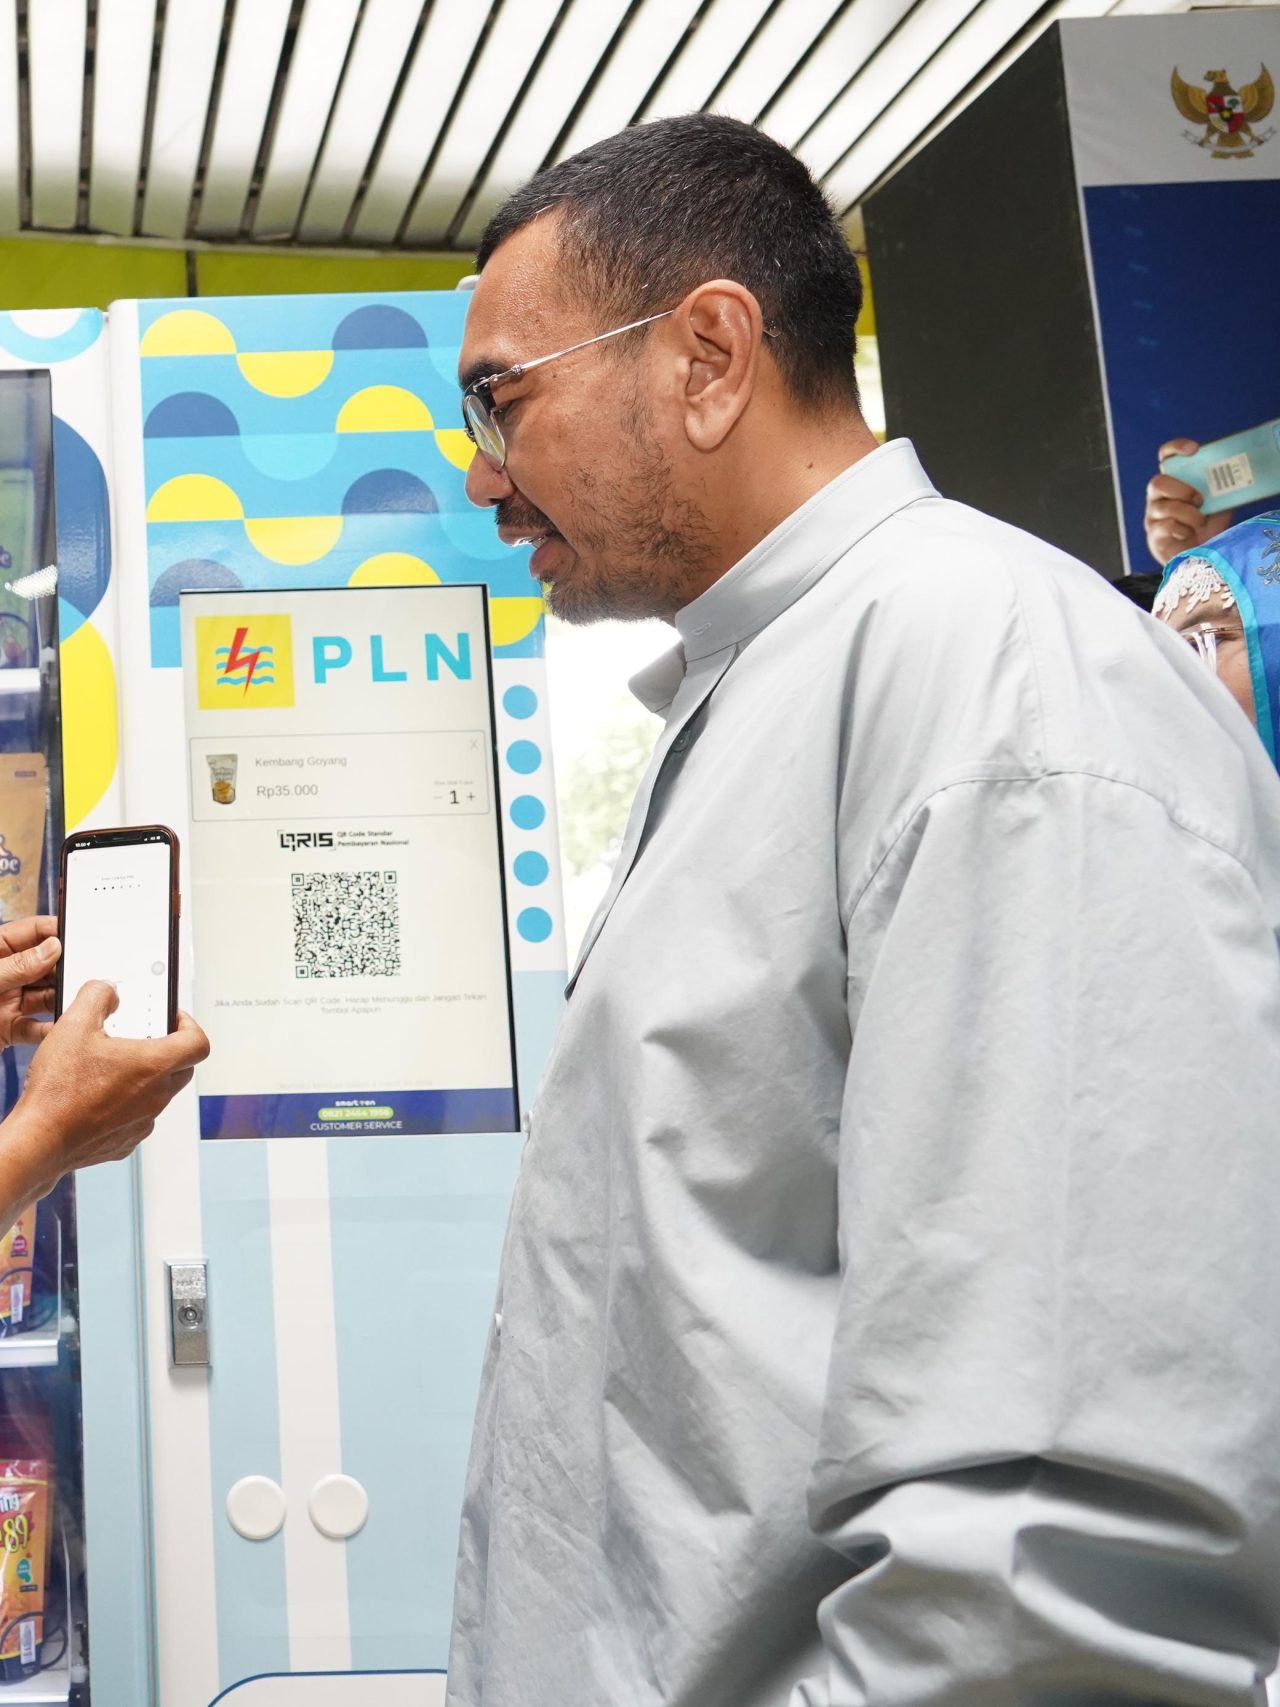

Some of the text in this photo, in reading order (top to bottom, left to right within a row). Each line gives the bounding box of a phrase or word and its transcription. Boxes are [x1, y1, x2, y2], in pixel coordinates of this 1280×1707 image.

[312, 632, 472, 685] PLN
[255, 756, 347, 768] Kembang Goyang
[449, 789, 460, 804] 1
[280, 832, 333, 851] QRIS
[310, 1120, 403, 1131] CUSTOMER SERVICE
